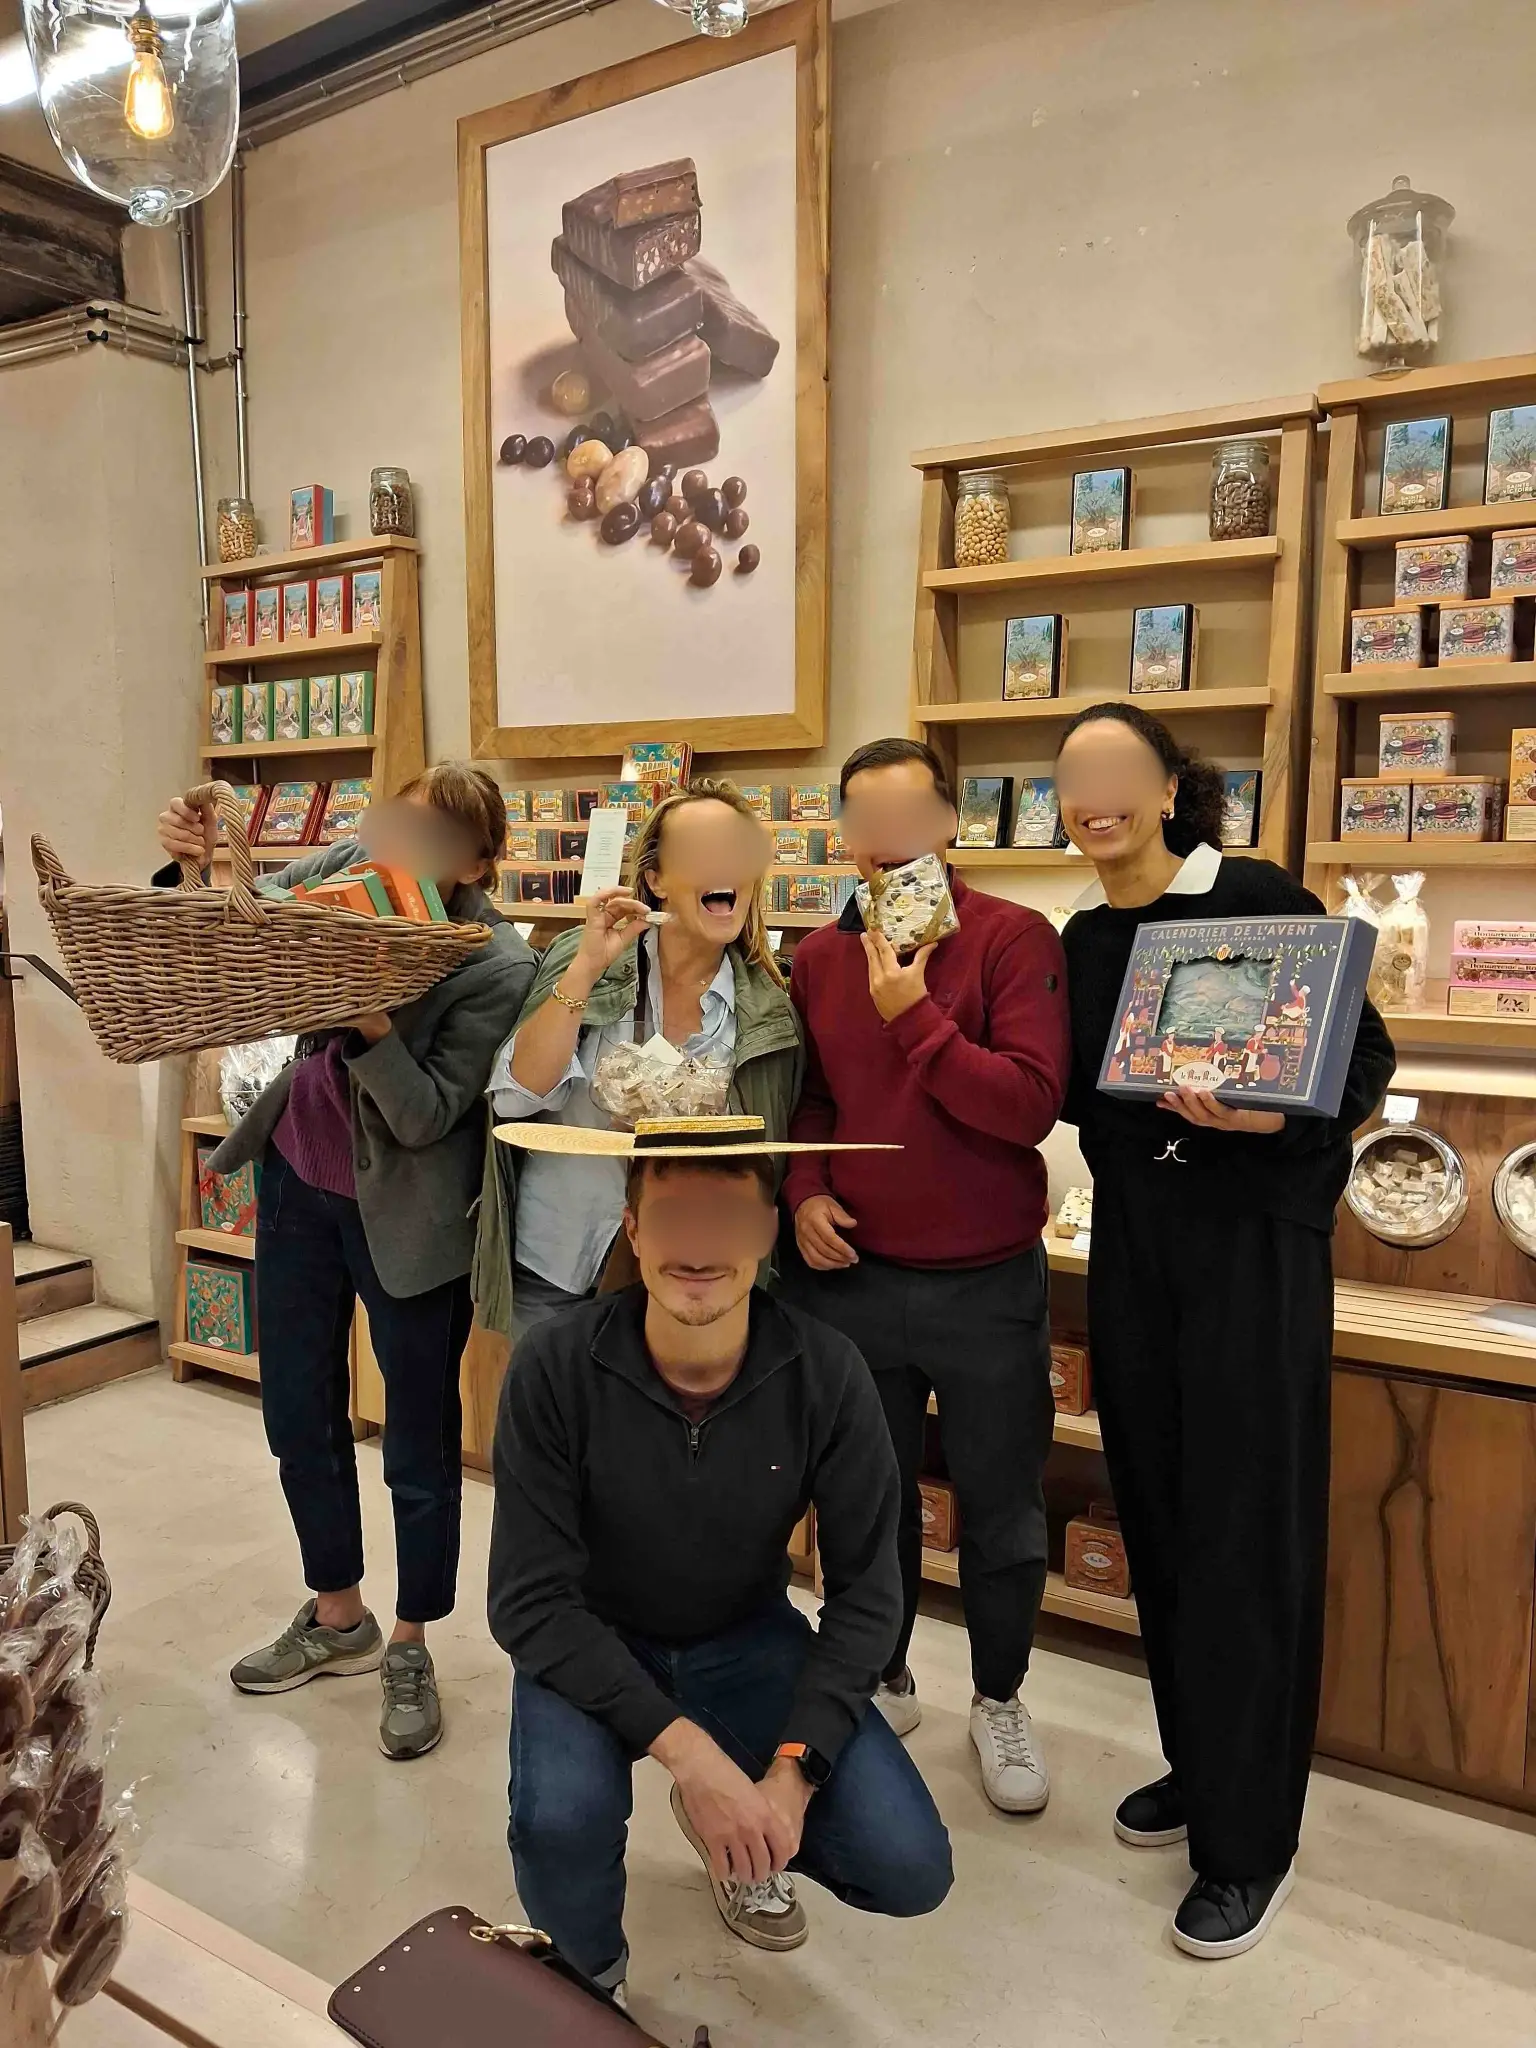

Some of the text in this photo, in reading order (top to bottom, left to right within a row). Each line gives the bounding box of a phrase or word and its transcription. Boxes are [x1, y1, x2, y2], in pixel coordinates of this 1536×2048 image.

[1150, 924, 1318, 941] CALENDRIER DE L'AVENT
